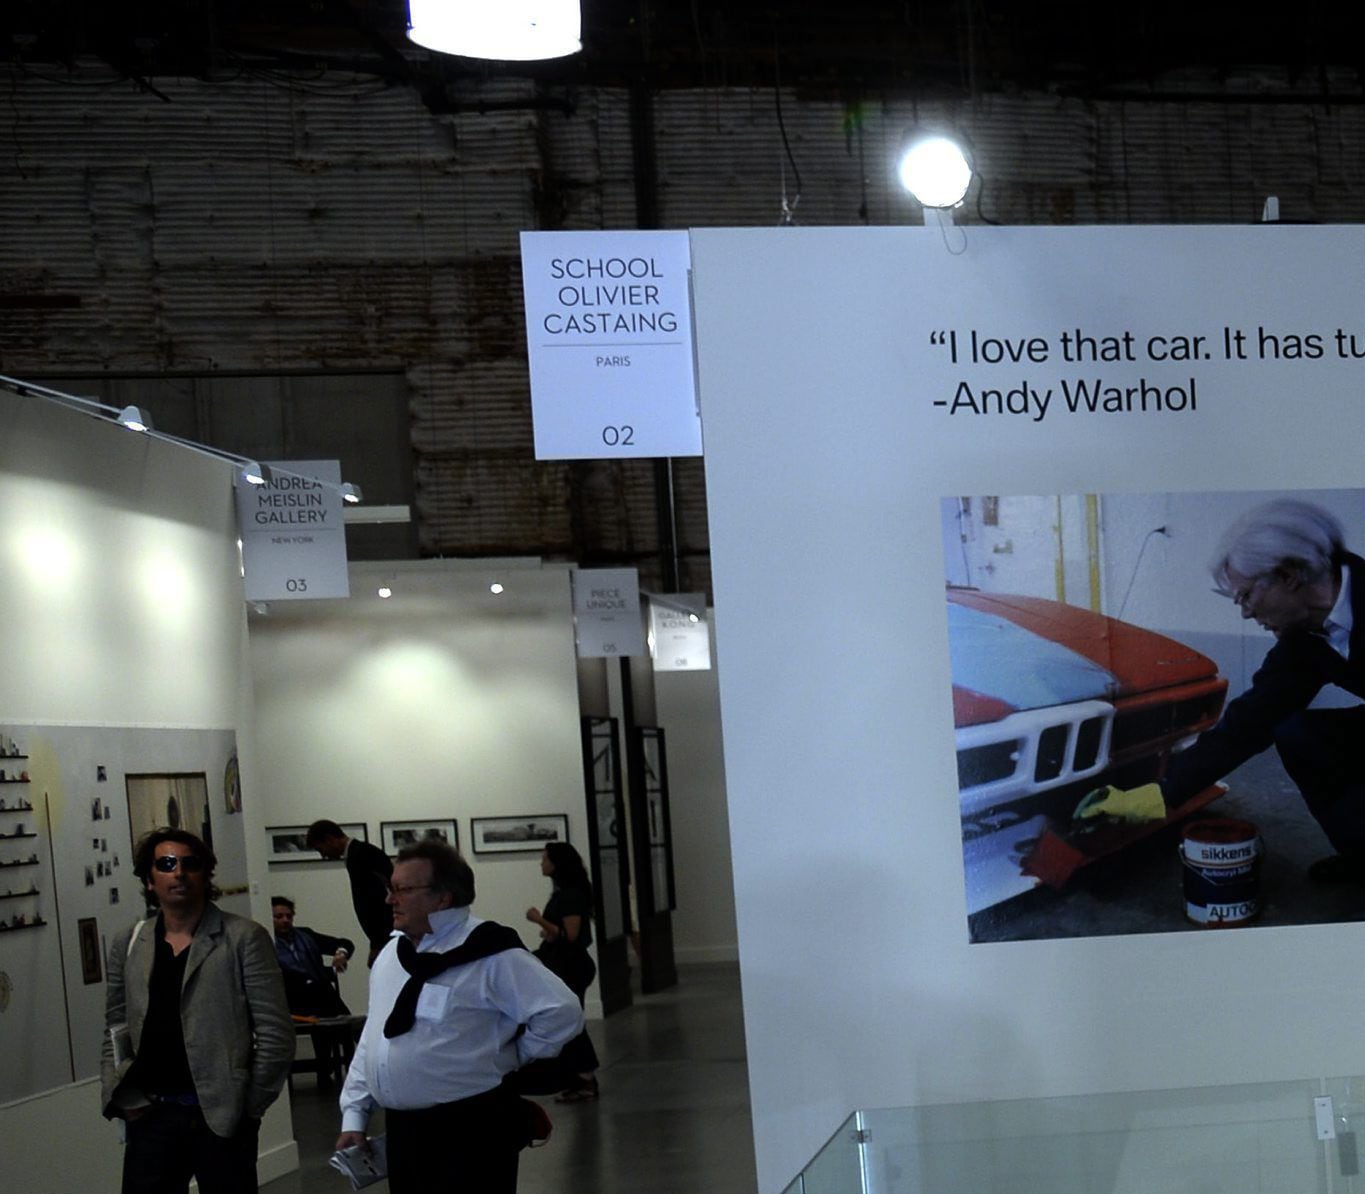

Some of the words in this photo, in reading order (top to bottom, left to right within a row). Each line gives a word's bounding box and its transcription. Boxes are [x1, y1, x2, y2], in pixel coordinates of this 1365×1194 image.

[551, 257, 664, 279] SCHOOL
[558, 285, 659, 307] OLIVIER
[543, 312, 678, 334] CASTAING
[930, 330, 957, 364] “I
[971, 330, 1049, 364] love
[1059, 328, 1137, 362] that
[1147, 336, 1211, 361] car.
[1224, 326, 1248, 360] It
[1258, 326, 1324, 360] has
[596, 355, 631, 367] PARIS
[933, 380, 1053, 422] -Andy
[1060, 377, 1197, 413] Warhol
[602, 425, 634, 446] 02
[256, 476, 323, 491] ANDREA
[258, 494, 322, 507] MEISLIN
[255, 510, 327, 524] GALLERY
[286, 579, 307, 592] 03
[1201, 846, 1251, 861] sikkens
